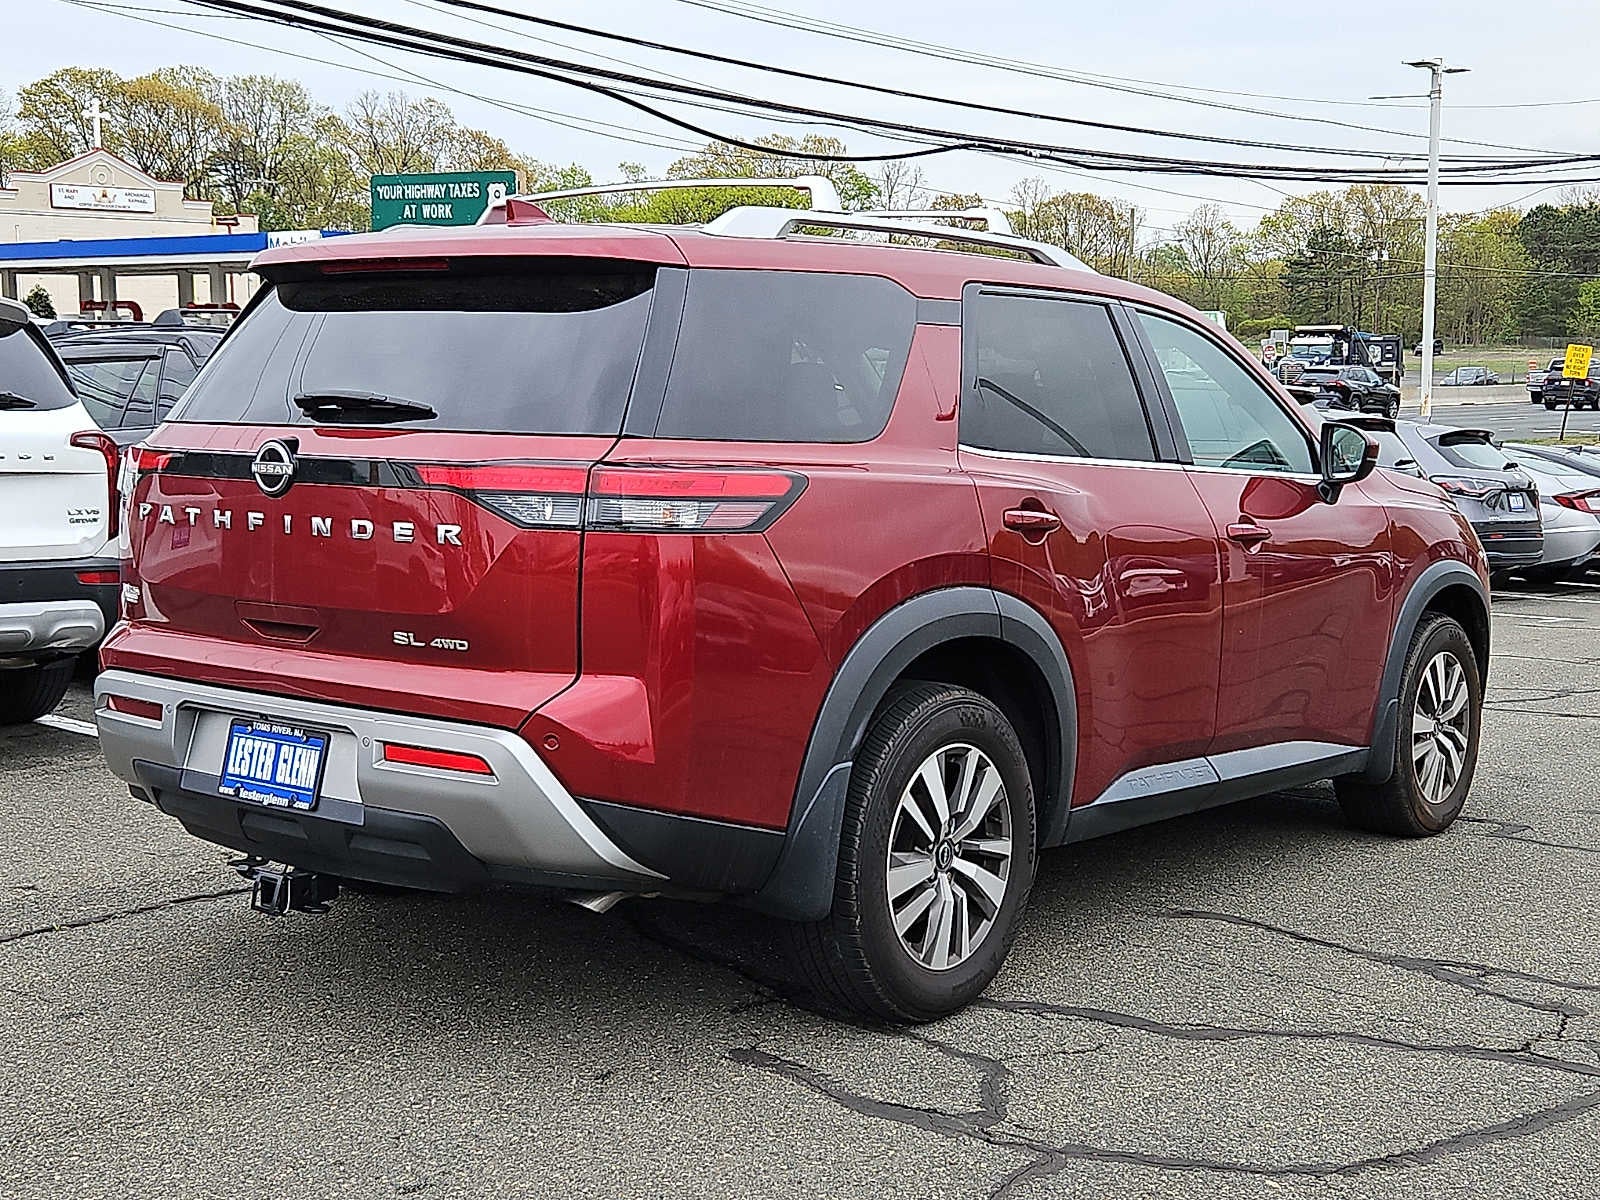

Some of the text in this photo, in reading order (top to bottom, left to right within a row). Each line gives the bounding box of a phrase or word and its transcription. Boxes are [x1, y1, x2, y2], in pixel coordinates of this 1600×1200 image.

[376, 182, 480, 200] YOUR HIGHWAY TAXES
[403, 204, 453, 219] AT WORK
[252, 462, 293, 475] NISSAN
[138, 502, 463, 547] PATHFINDER
[393, 631, 469, 650] SL 4WD
[252, 721, 272, 732] TOMS
[293, 728, 304, 737] NJ
[227, 736, 320, 789] LESTER GLENN
